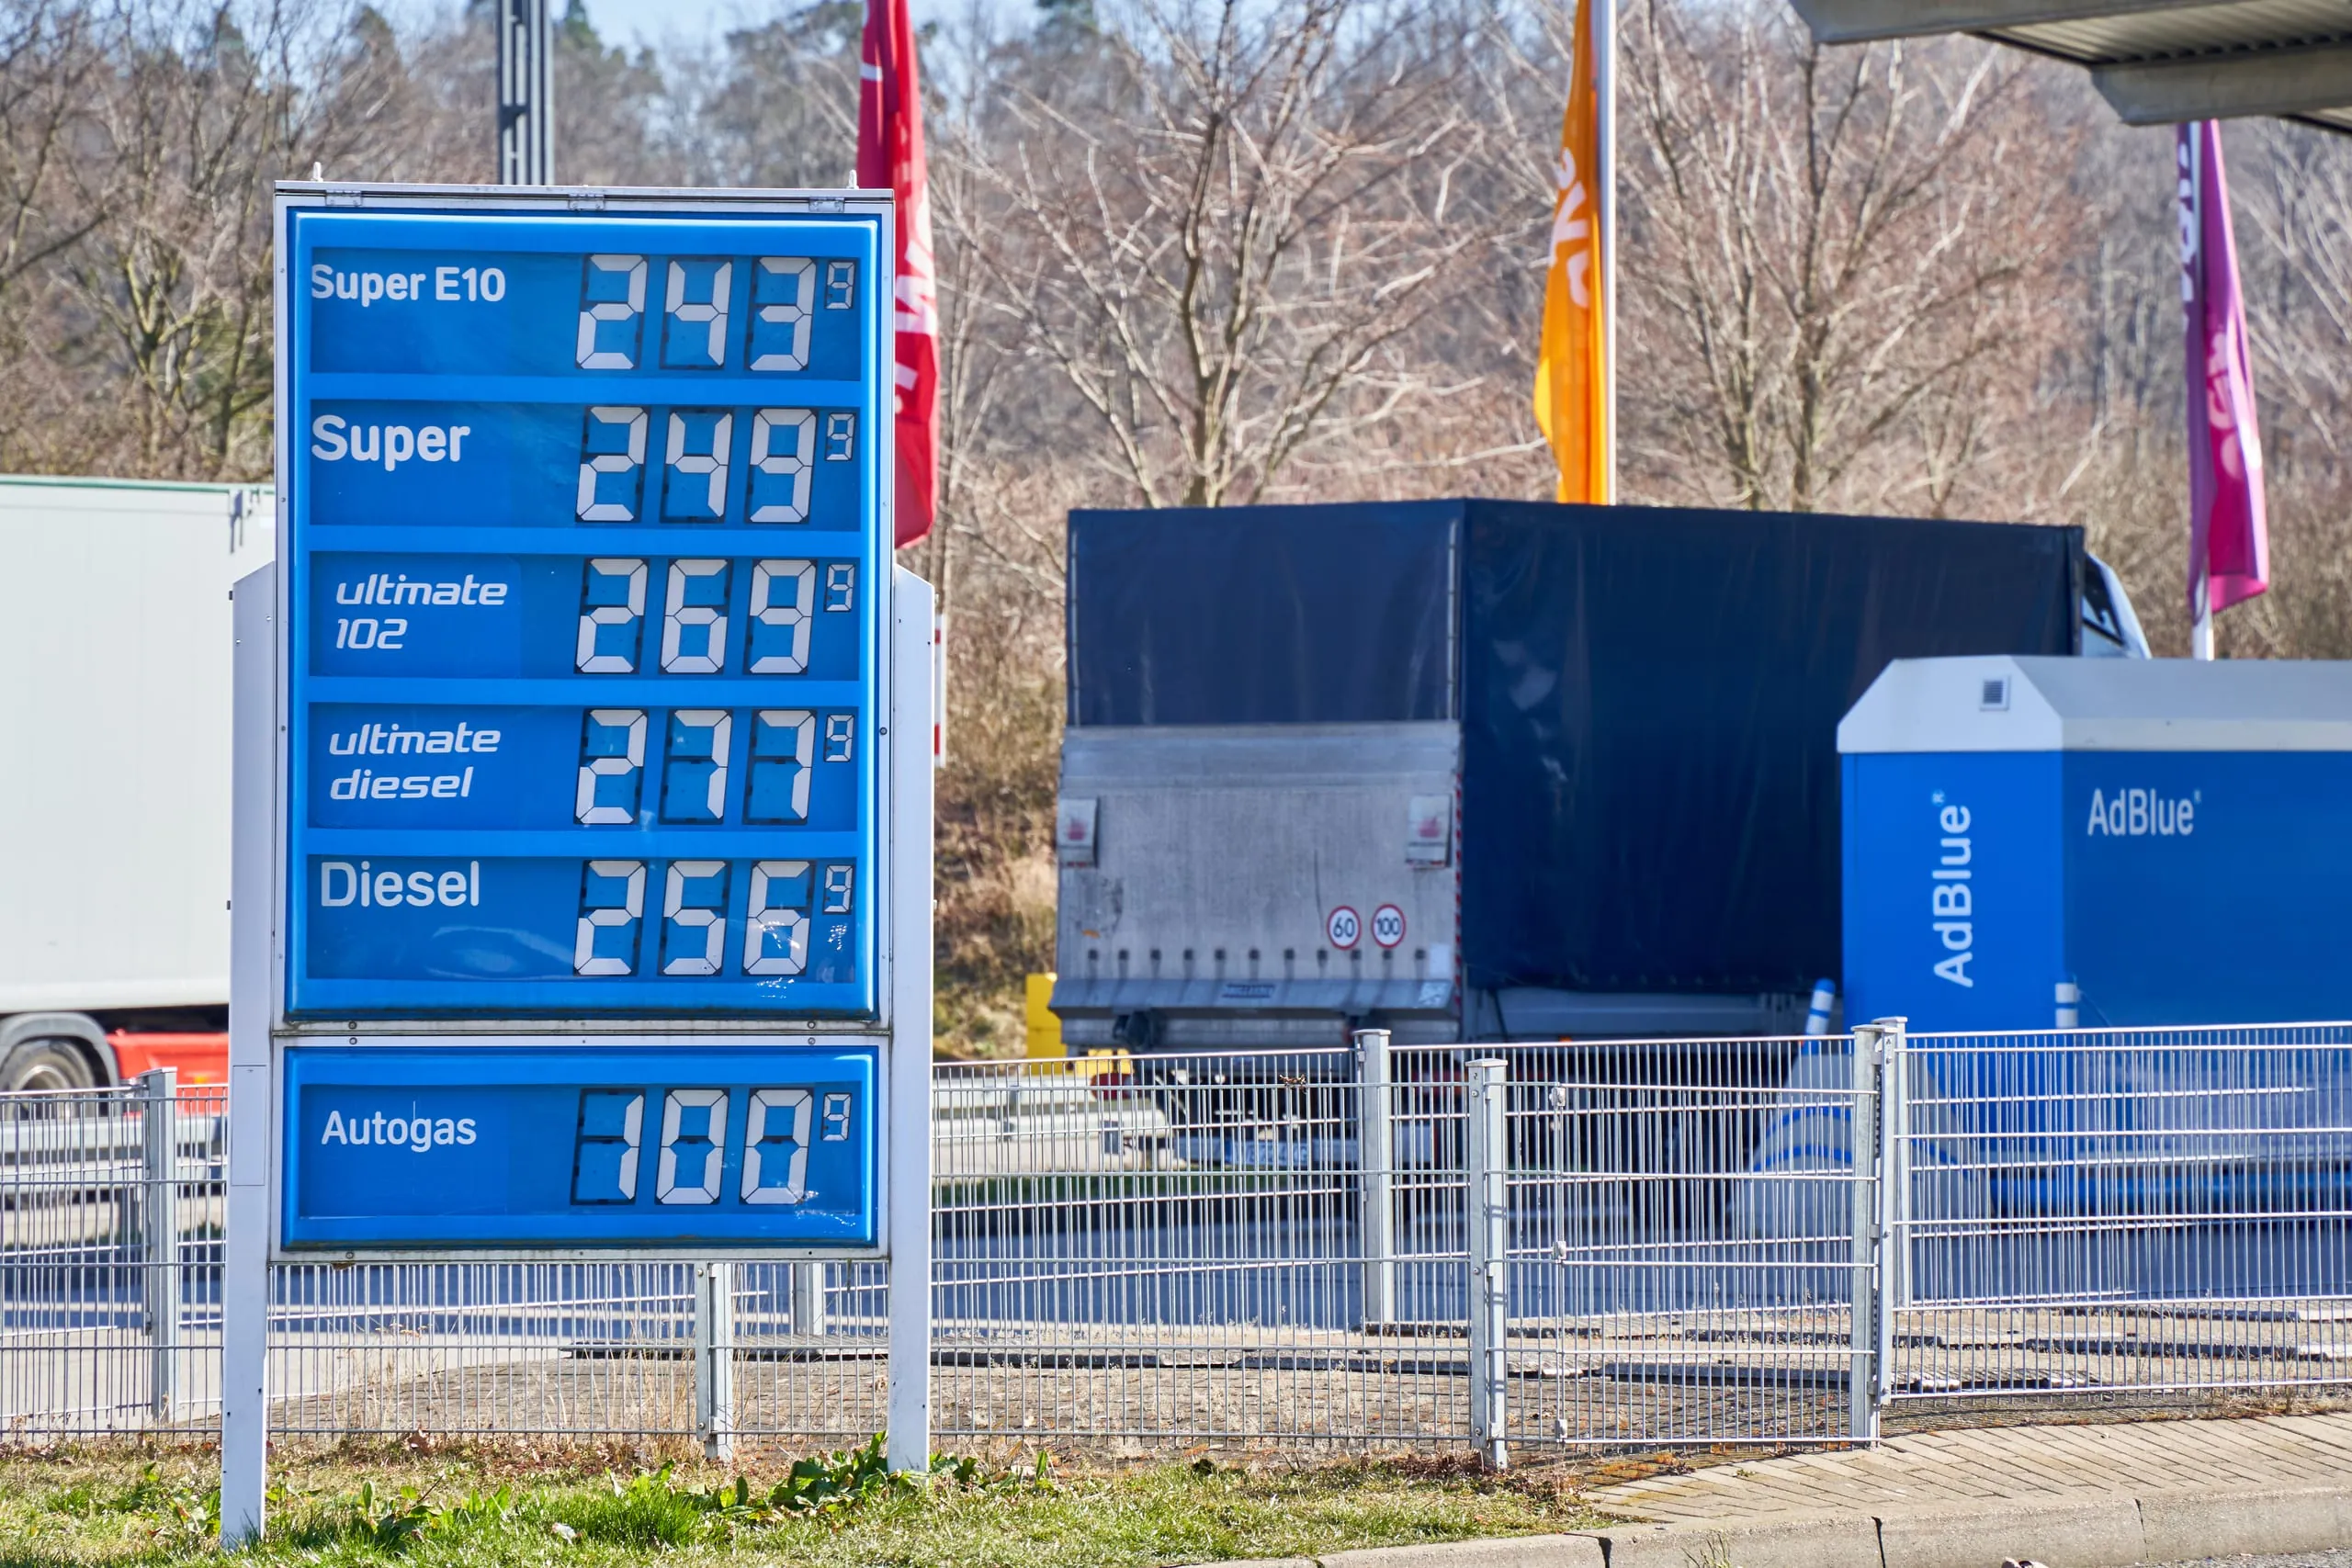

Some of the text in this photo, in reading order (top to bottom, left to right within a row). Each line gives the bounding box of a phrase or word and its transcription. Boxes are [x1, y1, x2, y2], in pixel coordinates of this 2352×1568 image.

[311, 264, 505, 308] Super E10
[311, 414, 470, 472] Super
[335, 573, 509, 606] ultimate
[335, 618, 408, 650] 102
[328, 722, 502, 756] ultimate
[329, 766, 474, 800] diesel
[321, 861, 480, 908] Diesel
[1333, 918, 1355, 937] 60
[1376, 917, 1400, 935] 100
[321, 1111, 478, 1153] Autogas
